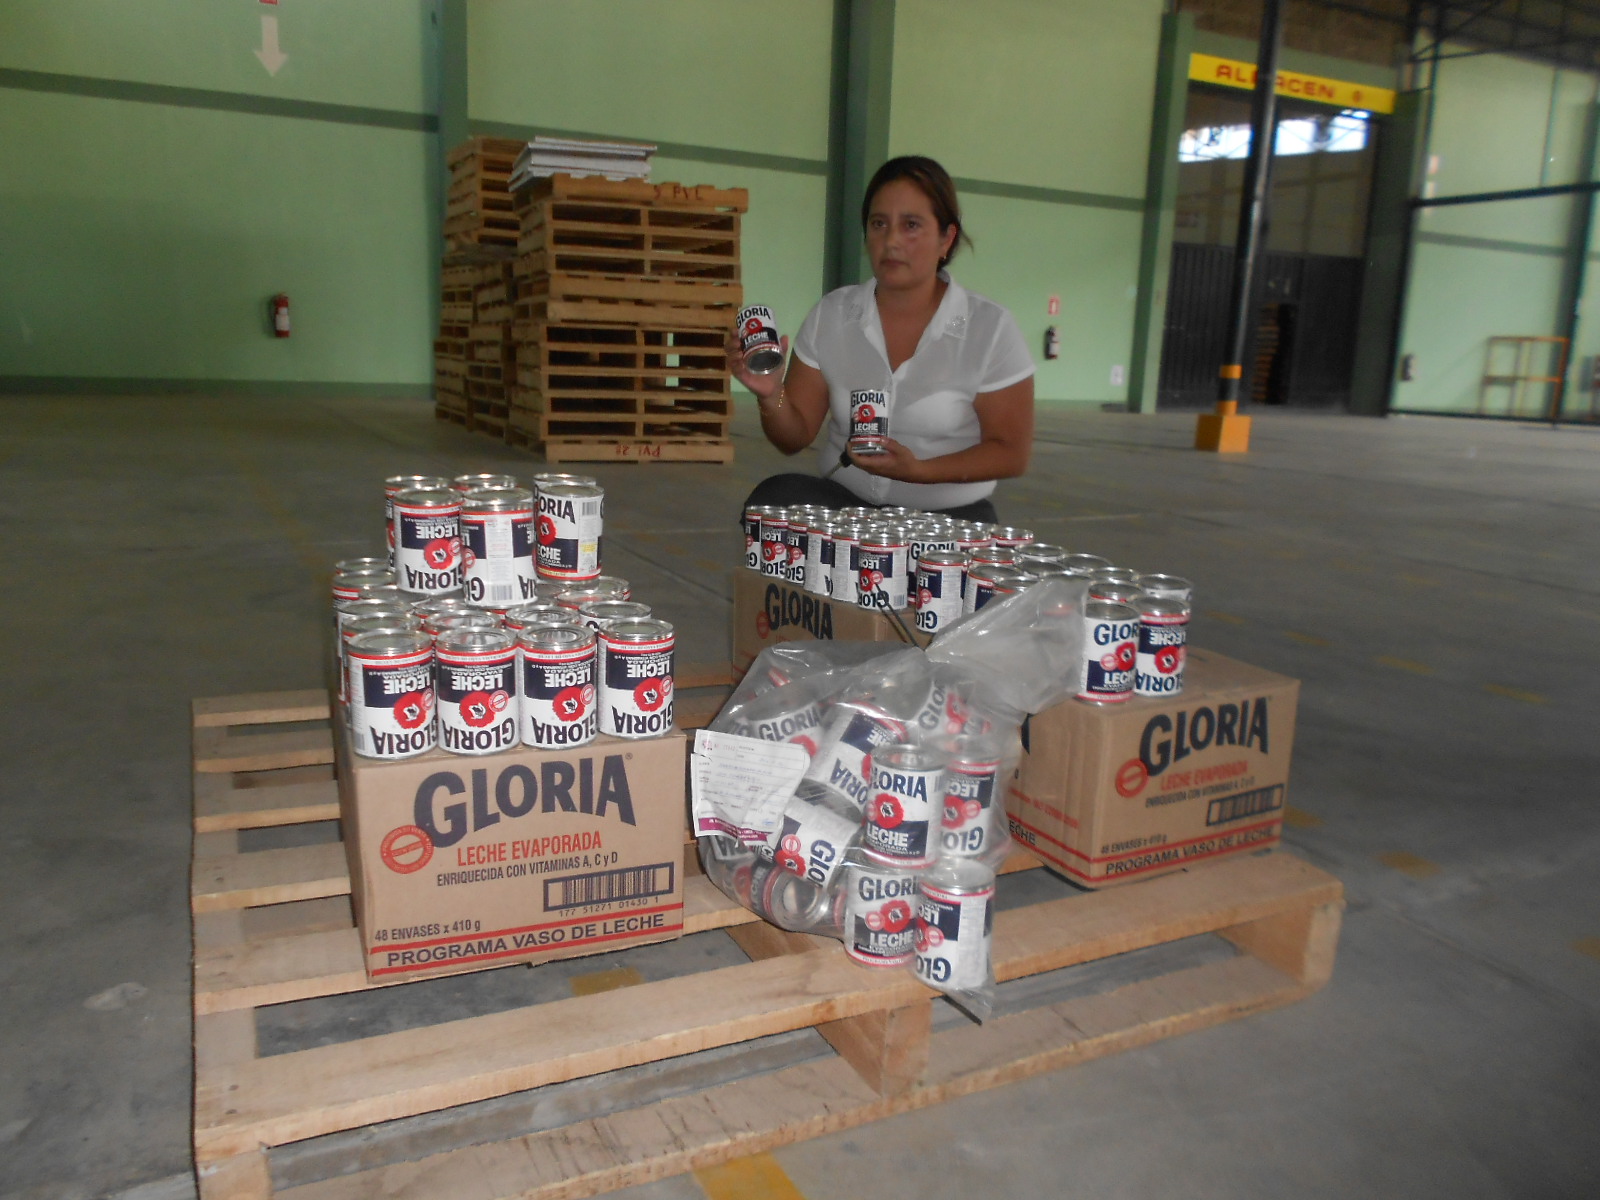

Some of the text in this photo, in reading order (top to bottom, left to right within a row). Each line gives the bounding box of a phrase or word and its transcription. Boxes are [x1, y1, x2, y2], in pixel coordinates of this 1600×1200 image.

[1216, 64, 1335, 98] ALACEN
[735, 307, 771, 328] GLORIA
[744, 331, 769, 345] LECHE
[851, 391, 886, 407] GLORIA
[855, 422, 878, 432] LECHE
[416, 523, 460, 539] LECHE
[765, 583, 833, 640] GLORIA
[545, 668, 591, 688] LECHE
[627, 660, 670, 678] LECHE
[384, 671, 431, 695] LECHE
[452, 674, 503, 691] LECHE
[612, 701, 673, 734] GLORIA
[442, 717, 517, 751] GLORIA
[1139, 697, 1269, 777] GLORIA
[414, 754, 636, 848] GLORIA
[867, 822, 908, 847] LECHE
[457, 842, 507, 867] LECHE
[512, 830, 603, 860] EVAPORADA
[1106, 827, 1273, 874] PROGRAMA VASO DE LECHE
[437, 851, 618, 887] ENRIQUECIDA CON VITAMINAS A, C y D
[559, 908, 576, 918] 177
[374, 920, 481, 942] 48 ENVASES x 410 g
[387, 914, 664, 967] PROGRAMA VASO DE LECHE
